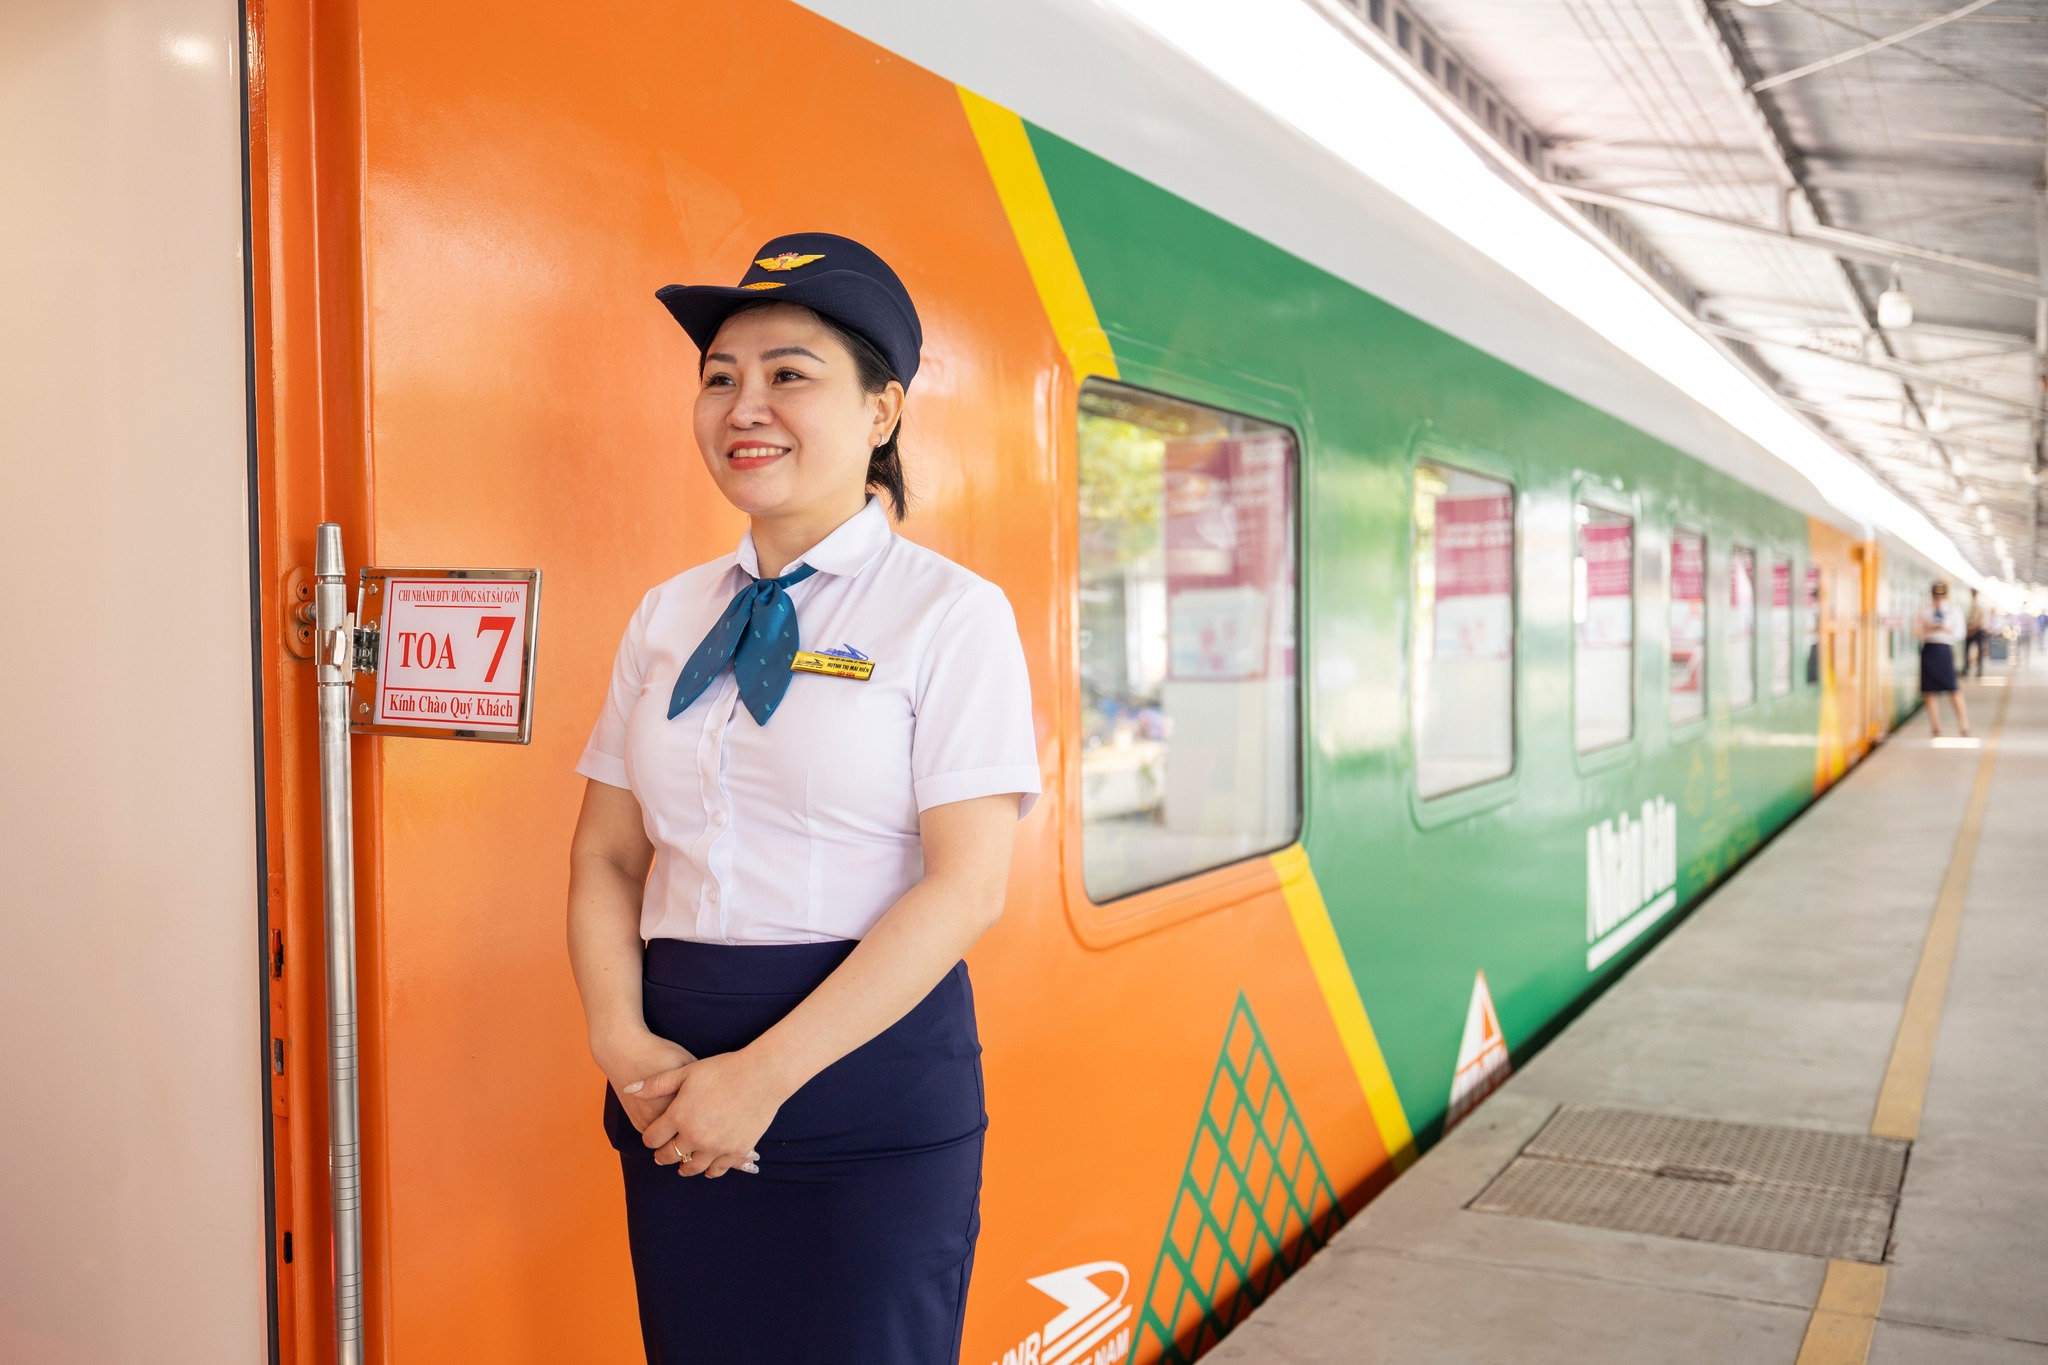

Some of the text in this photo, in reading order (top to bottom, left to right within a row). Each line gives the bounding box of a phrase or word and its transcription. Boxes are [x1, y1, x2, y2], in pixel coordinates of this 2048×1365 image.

[398, 589, 411, 602] CHI
[411, 586, 436, 602] NHÁNH
[451, 586, 476, 603] ĐƯỜNG
[504, 587, 520, 604] GÒN
[398, 616, 516, 683] TOA 7
[389, 694, 513, 720] Kính Chào Quý Khách
